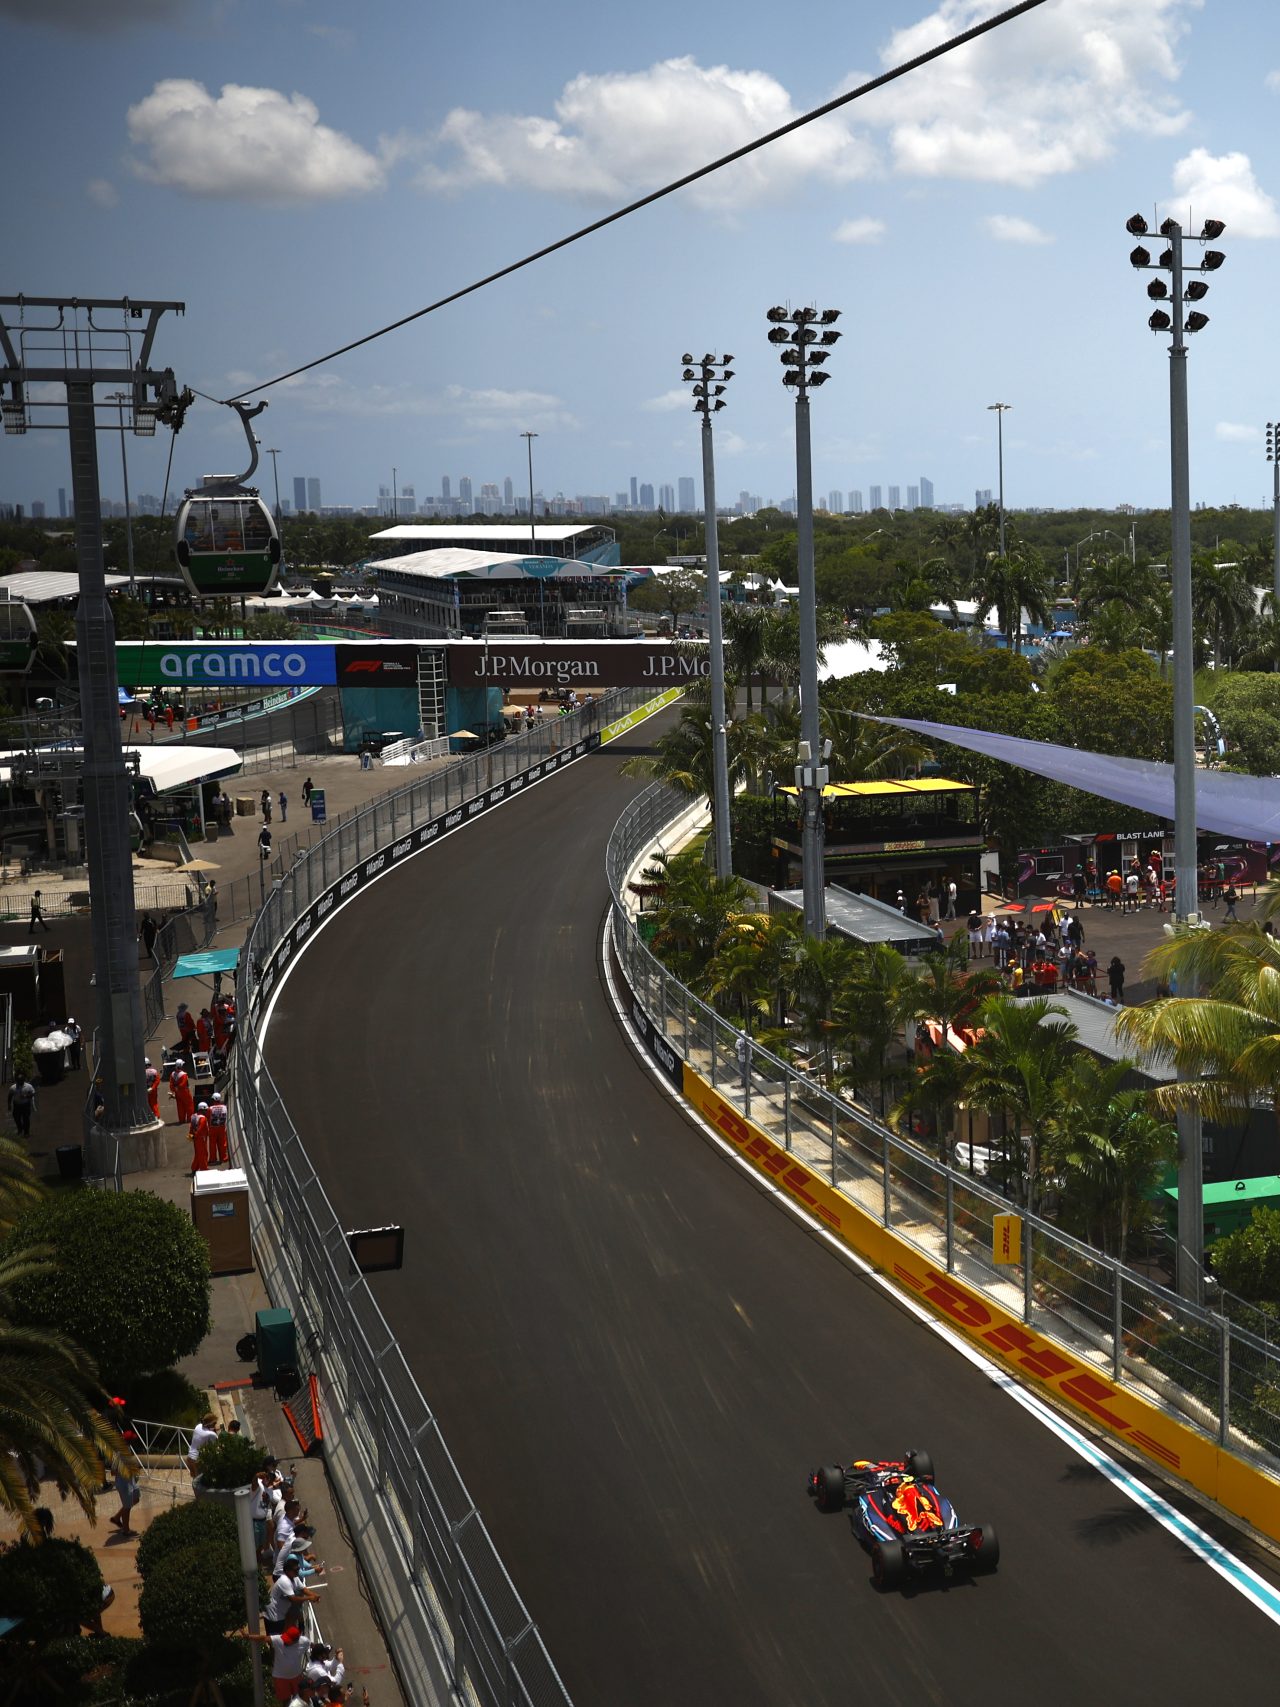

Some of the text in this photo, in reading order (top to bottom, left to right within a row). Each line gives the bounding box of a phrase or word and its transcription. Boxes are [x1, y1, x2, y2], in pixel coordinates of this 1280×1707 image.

[160, 653, 306, 678] aramco
[474, 655, 600, 683] J.P.Morgan
[420, 823, 438, 842] #MiamiGP
[1117, 832, 1142, 840] BLAST
[392, 838, 412, 858] #MiamiGP
[715, 1103, 818, 1206] DHL
[1002, 1224, 1010, 1256] DHL
[923, 1271, 1132, 1431] DHL
